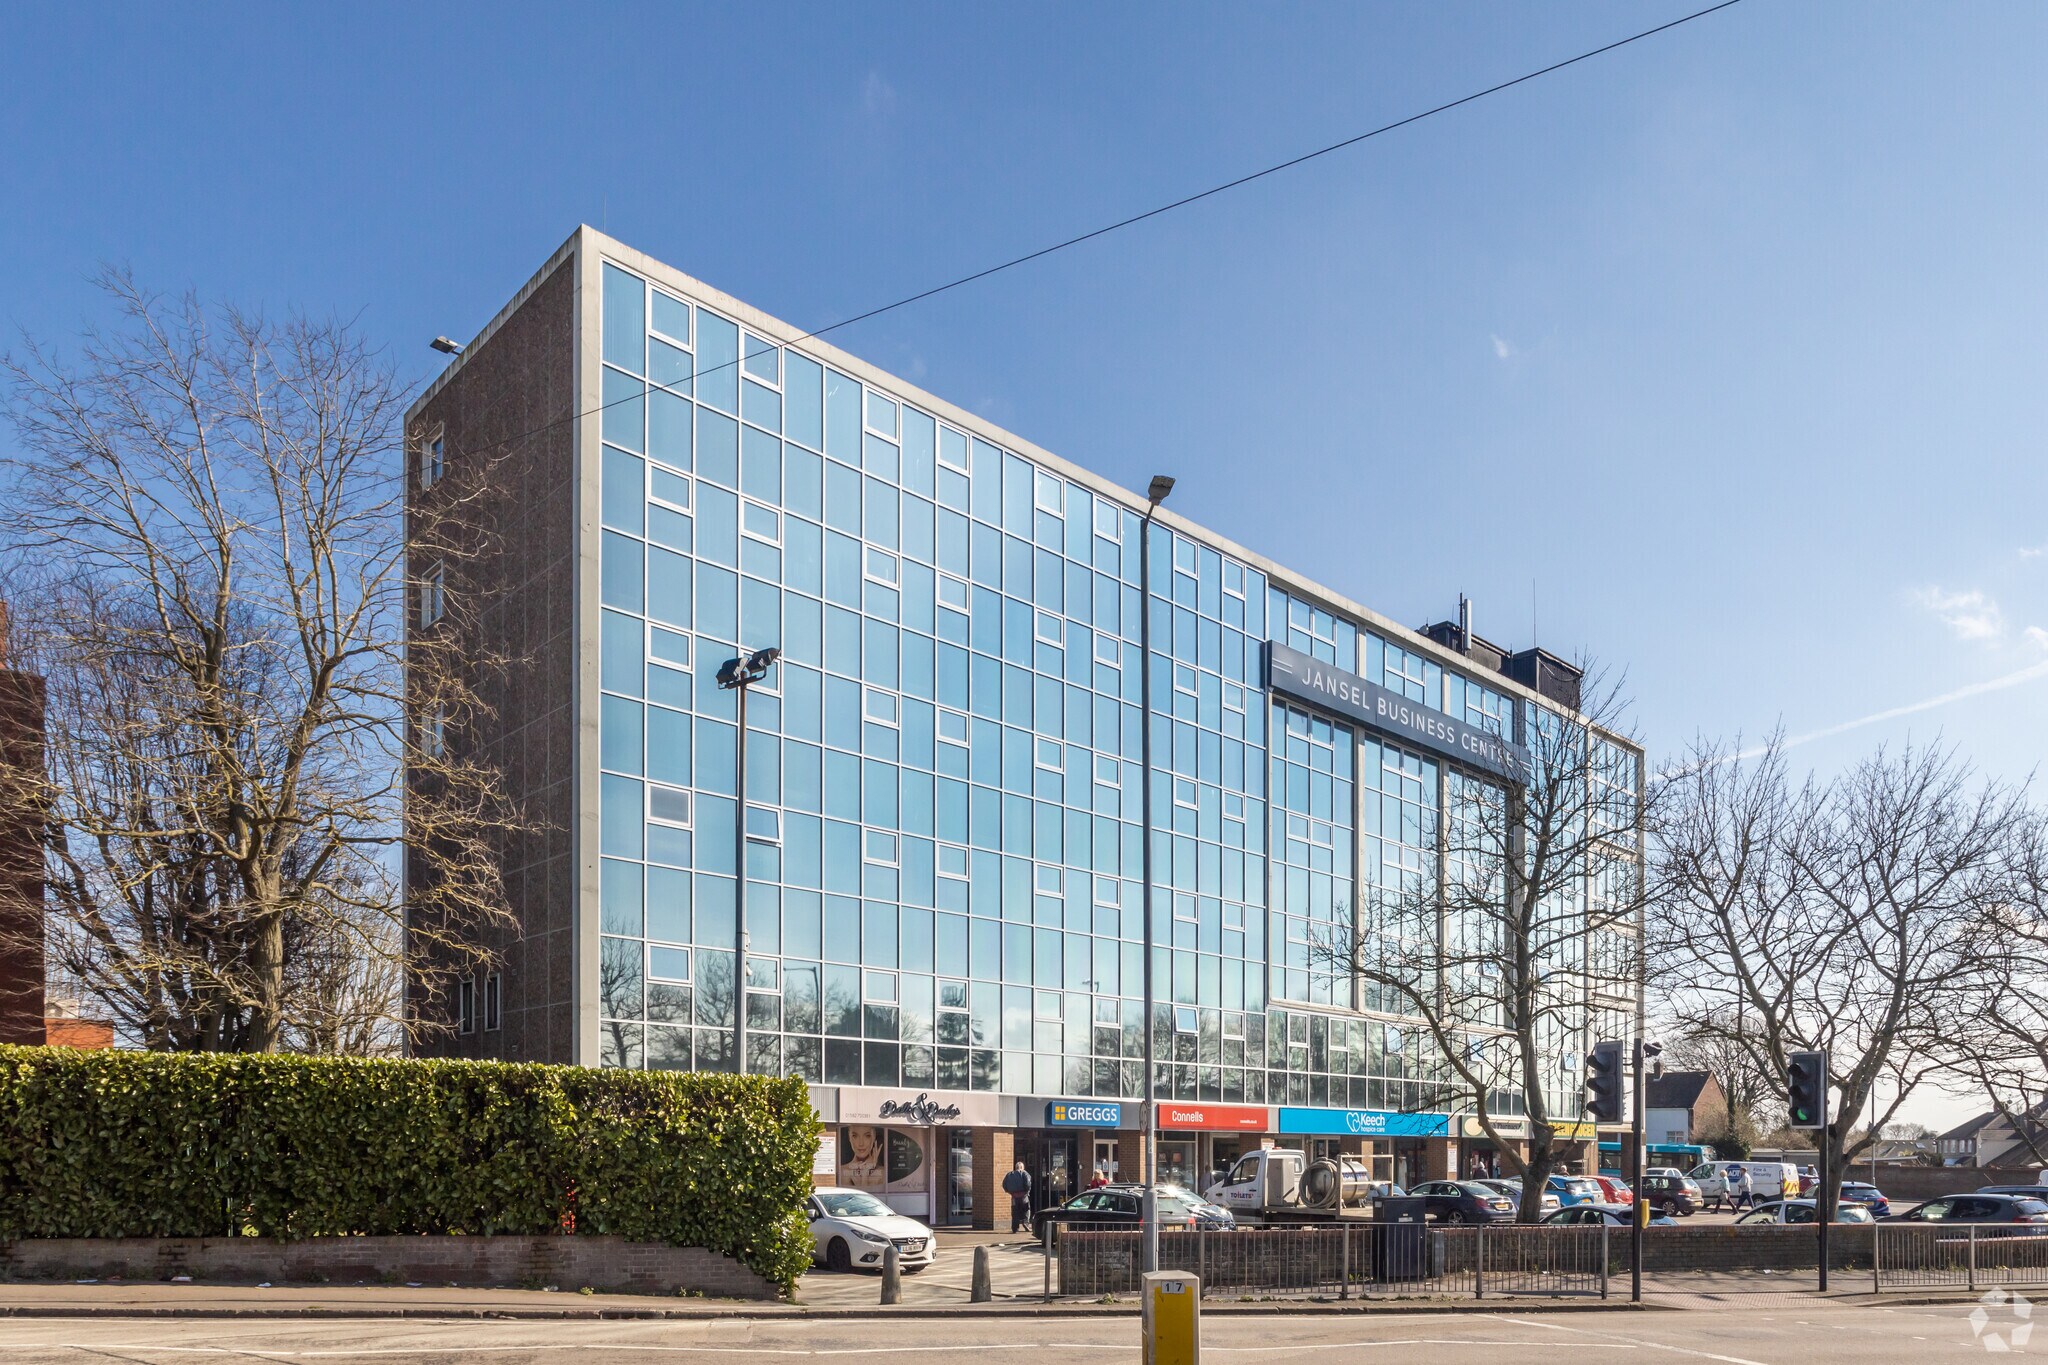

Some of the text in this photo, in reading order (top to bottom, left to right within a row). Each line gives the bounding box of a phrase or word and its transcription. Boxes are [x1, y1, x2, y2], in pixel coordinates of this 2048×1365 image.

[1302, 668, 1370, 710] JANSEL
[1378, 697, 1455, 744] BUSINESS
[1068, 1106, 1118, 1122] GREGGS
[1172, 1110, 1204, 1123] Connells
[1360, 1113, 1386, 1126] Keech
[1727, 1169, 1741, 1177] ADT
